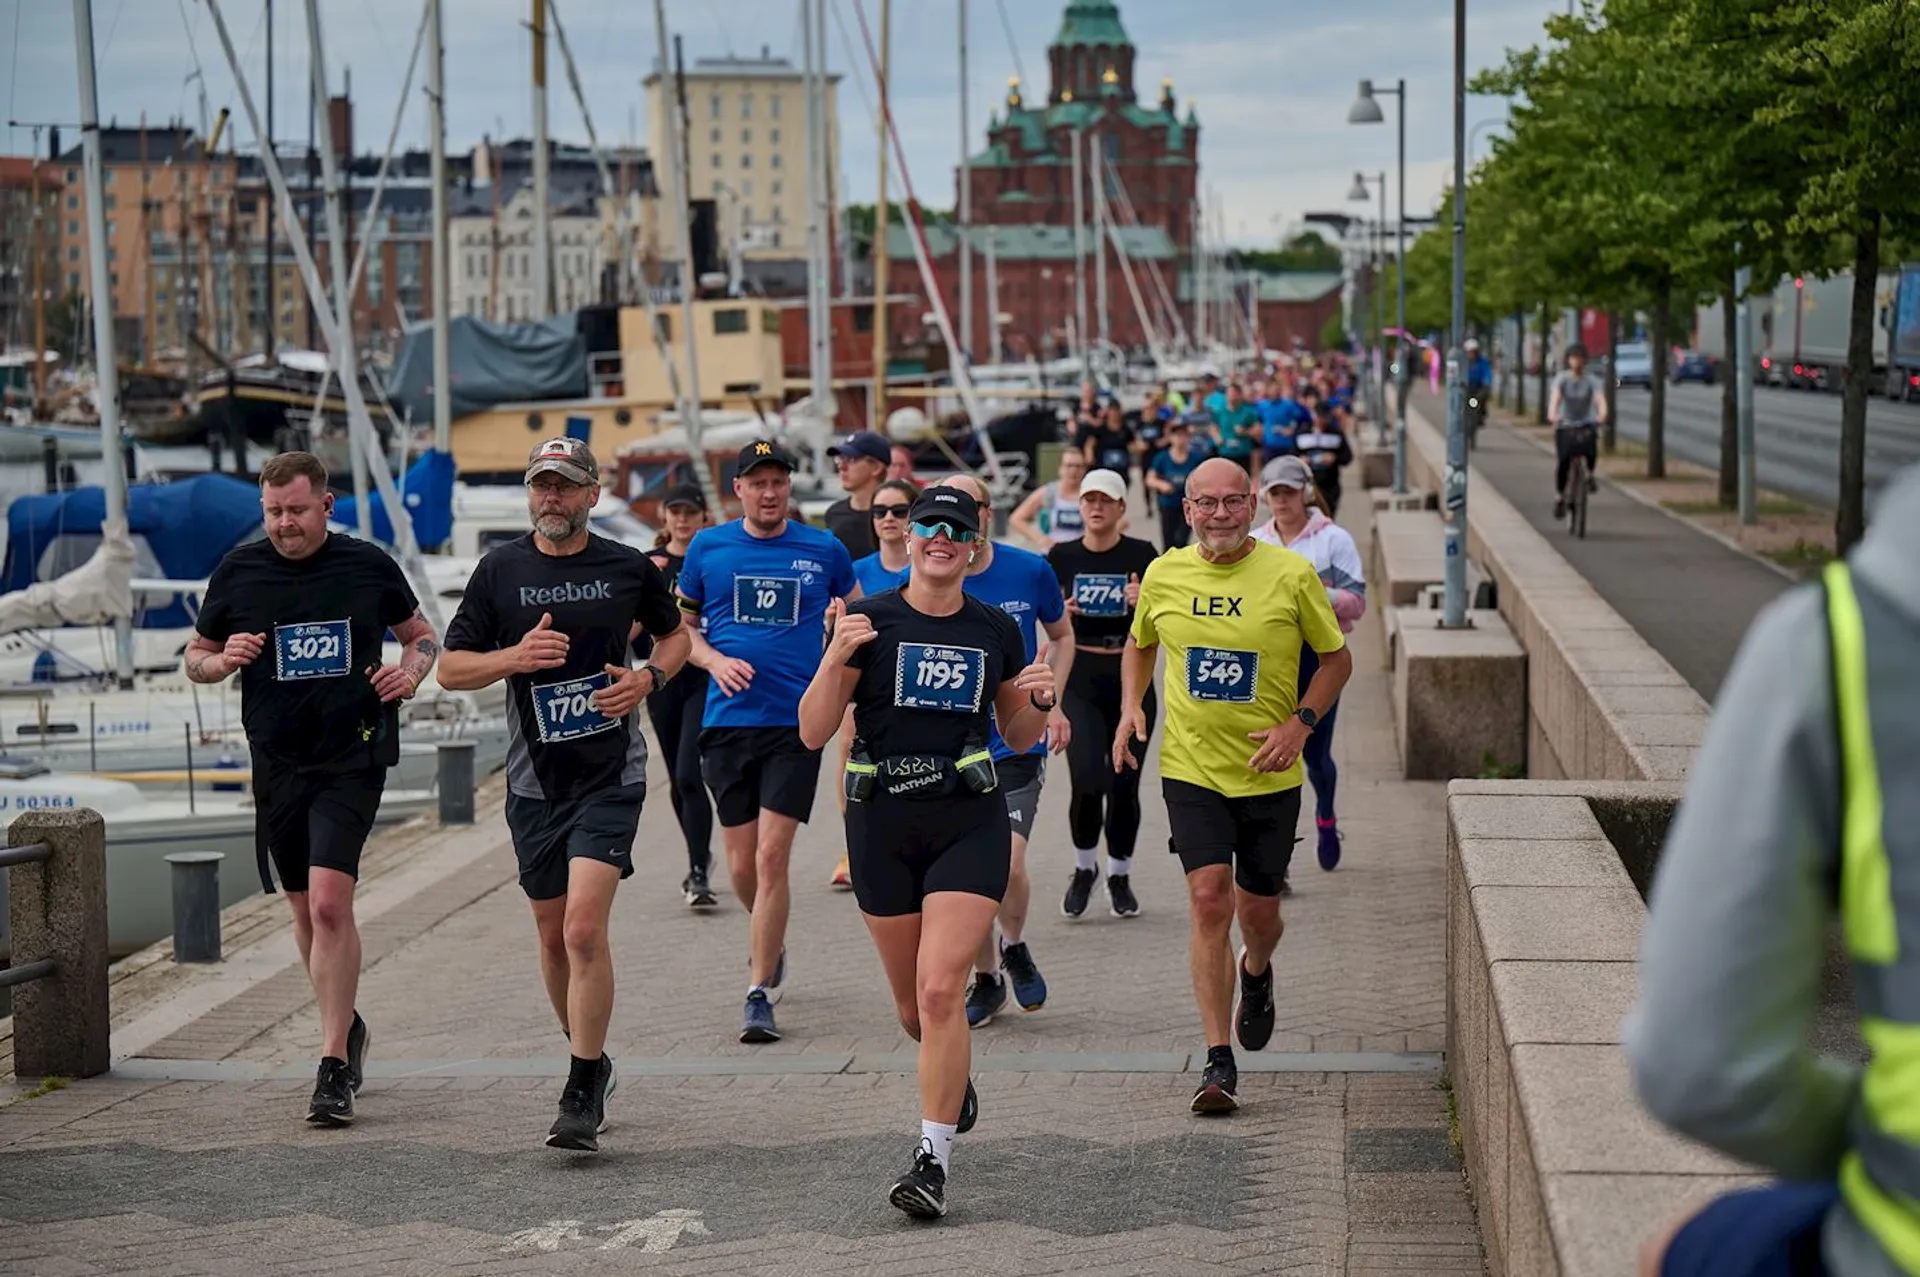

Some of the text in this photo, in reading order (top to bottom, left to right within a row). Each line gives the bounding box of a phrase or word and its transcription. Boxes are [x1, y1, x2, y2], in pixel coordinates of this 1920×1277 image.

[519, 580, 612, 606] Reebok
[756, 589, 777, 609] 10
[1078, 585, 1123, 604] 2774
[1192, 597, 1243, 616] LEX
[287, 635, 340, 661] 3021
[916, 660, 969, 689] 1195
[1196, 660, 1244, 686] 549
[888, 771, 943, 795] NATHAN
